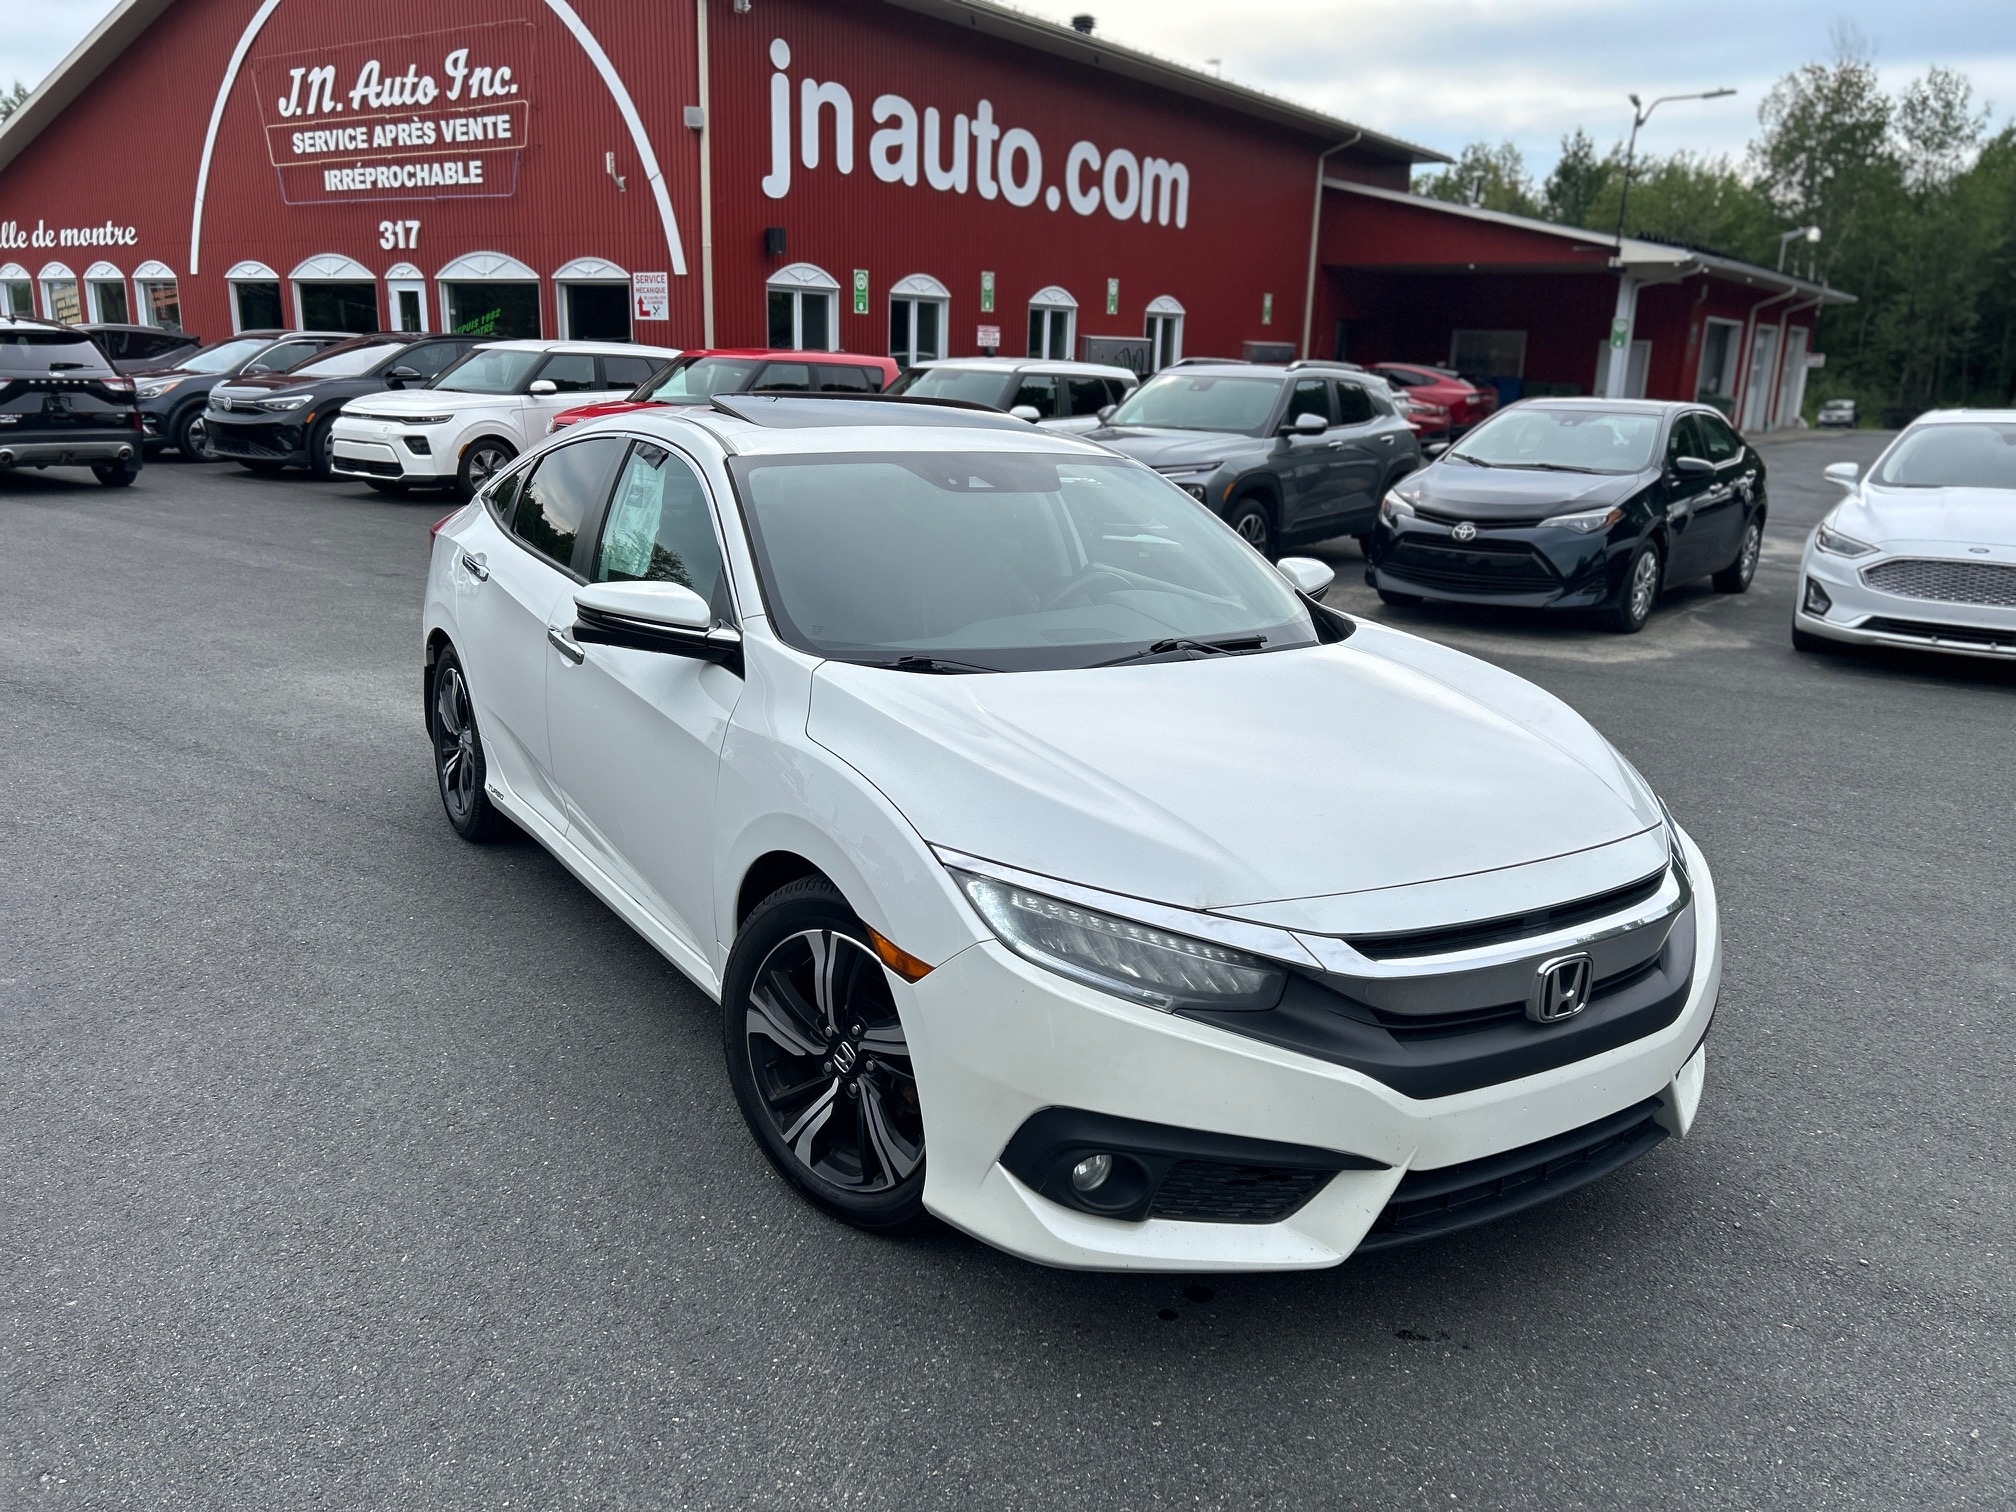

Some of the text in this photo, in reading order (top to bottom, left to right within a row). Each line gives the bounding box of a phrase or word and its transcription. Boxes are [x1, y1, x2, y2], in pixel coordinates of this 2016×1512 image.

[278, 48, 519, 118] J.N. Auto Inc.
[292, 114, 512, 154] SERVICE APRÈS VENTE
[324, 160, 484, 192] IRRÉPROCHABLE
[31, 219, 58, 248] de
[60, 220, 138, 247] montre
[379, 220, 421, 250] 317
[635, 274, 666, 284] SERVICE
[480, 307, 502, 325] 1982
[488, 783, 505, 801] TURBO
